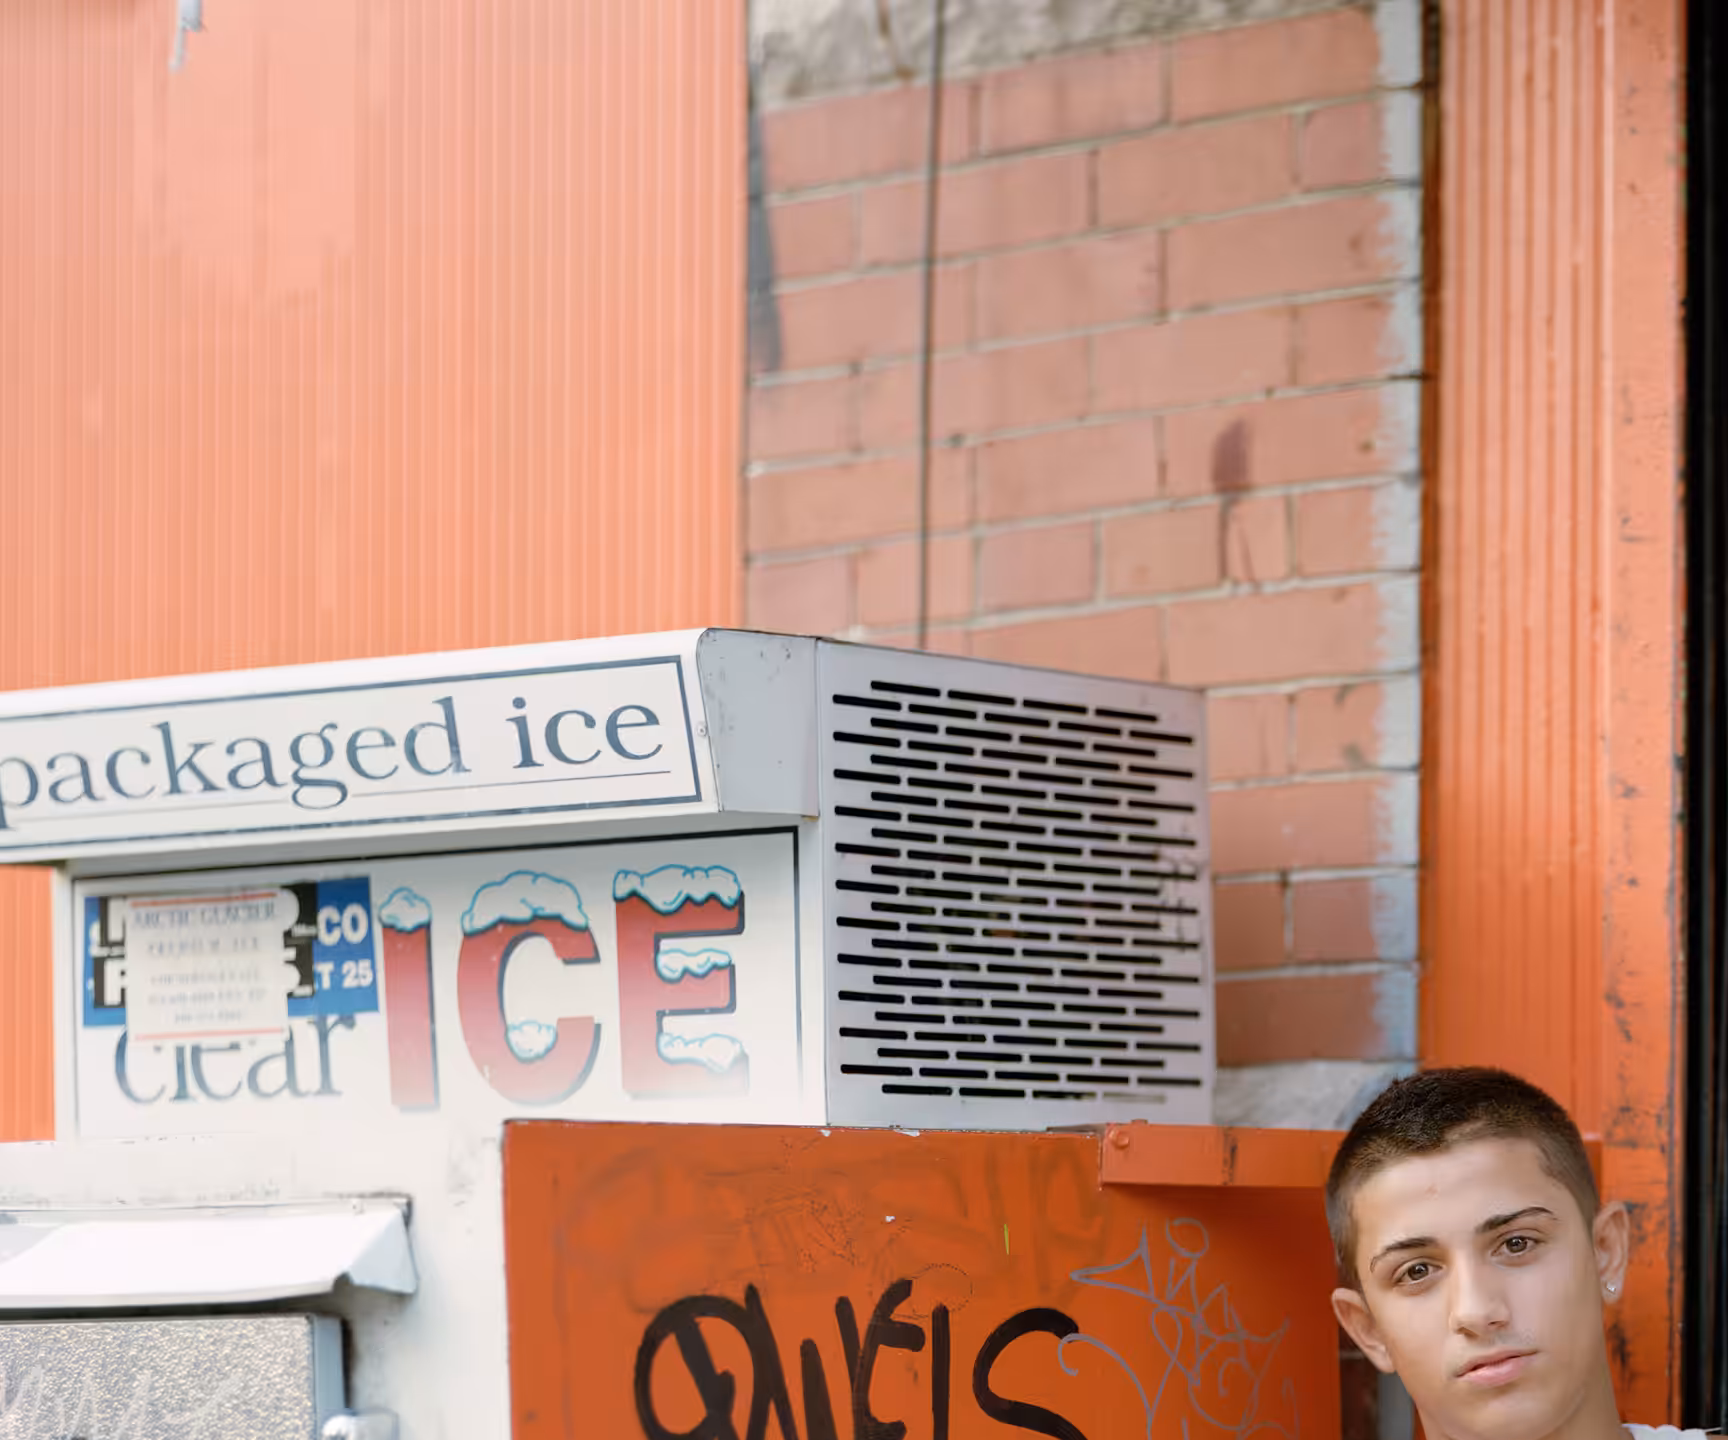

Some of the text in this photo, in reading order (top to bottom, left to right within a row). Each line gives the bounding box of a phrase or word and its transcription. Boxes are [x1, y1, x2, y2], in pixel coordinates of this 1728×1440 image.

[0, 696, 664, 831] packaged ice
[342, 959, 373, 989] 25
[378, 863, 750, 1111] ICE
